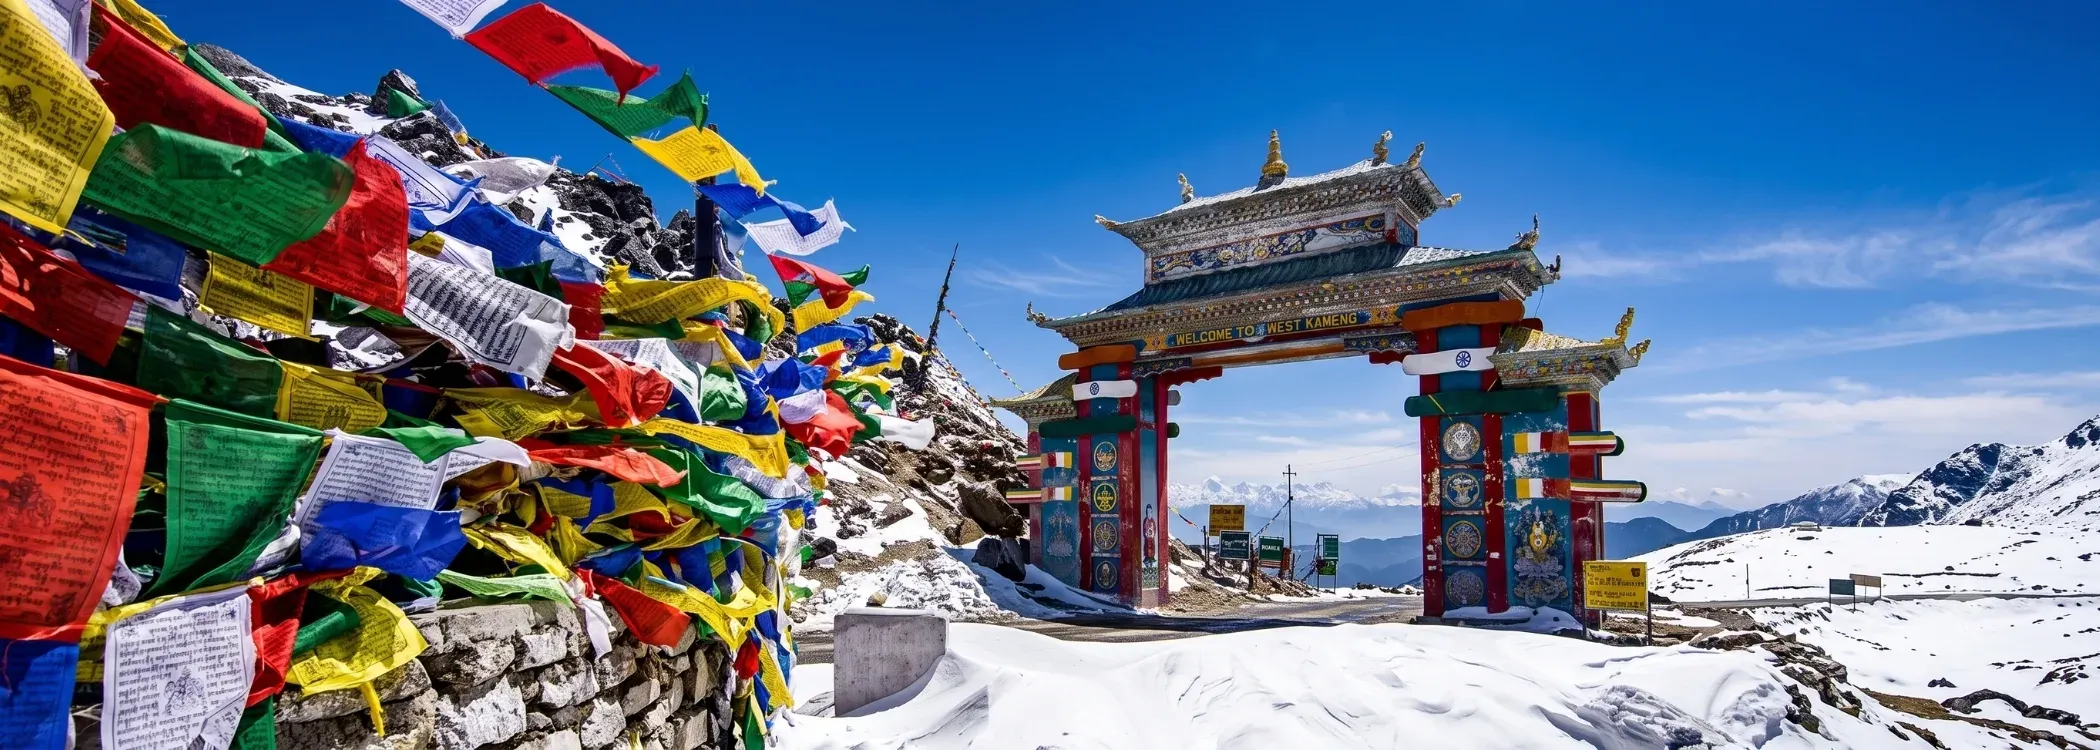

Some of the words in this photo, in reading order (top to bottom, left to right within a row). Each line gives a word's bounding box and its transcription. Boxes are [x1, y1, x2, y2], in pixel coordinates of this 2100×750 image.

[1176, 328, 1233, 346] WELCOME
[1236, 325, 1255, 338] TO
[1267, 319, 1301, 334] WEST
[1305, 313, 1357, 329] KAMENG
